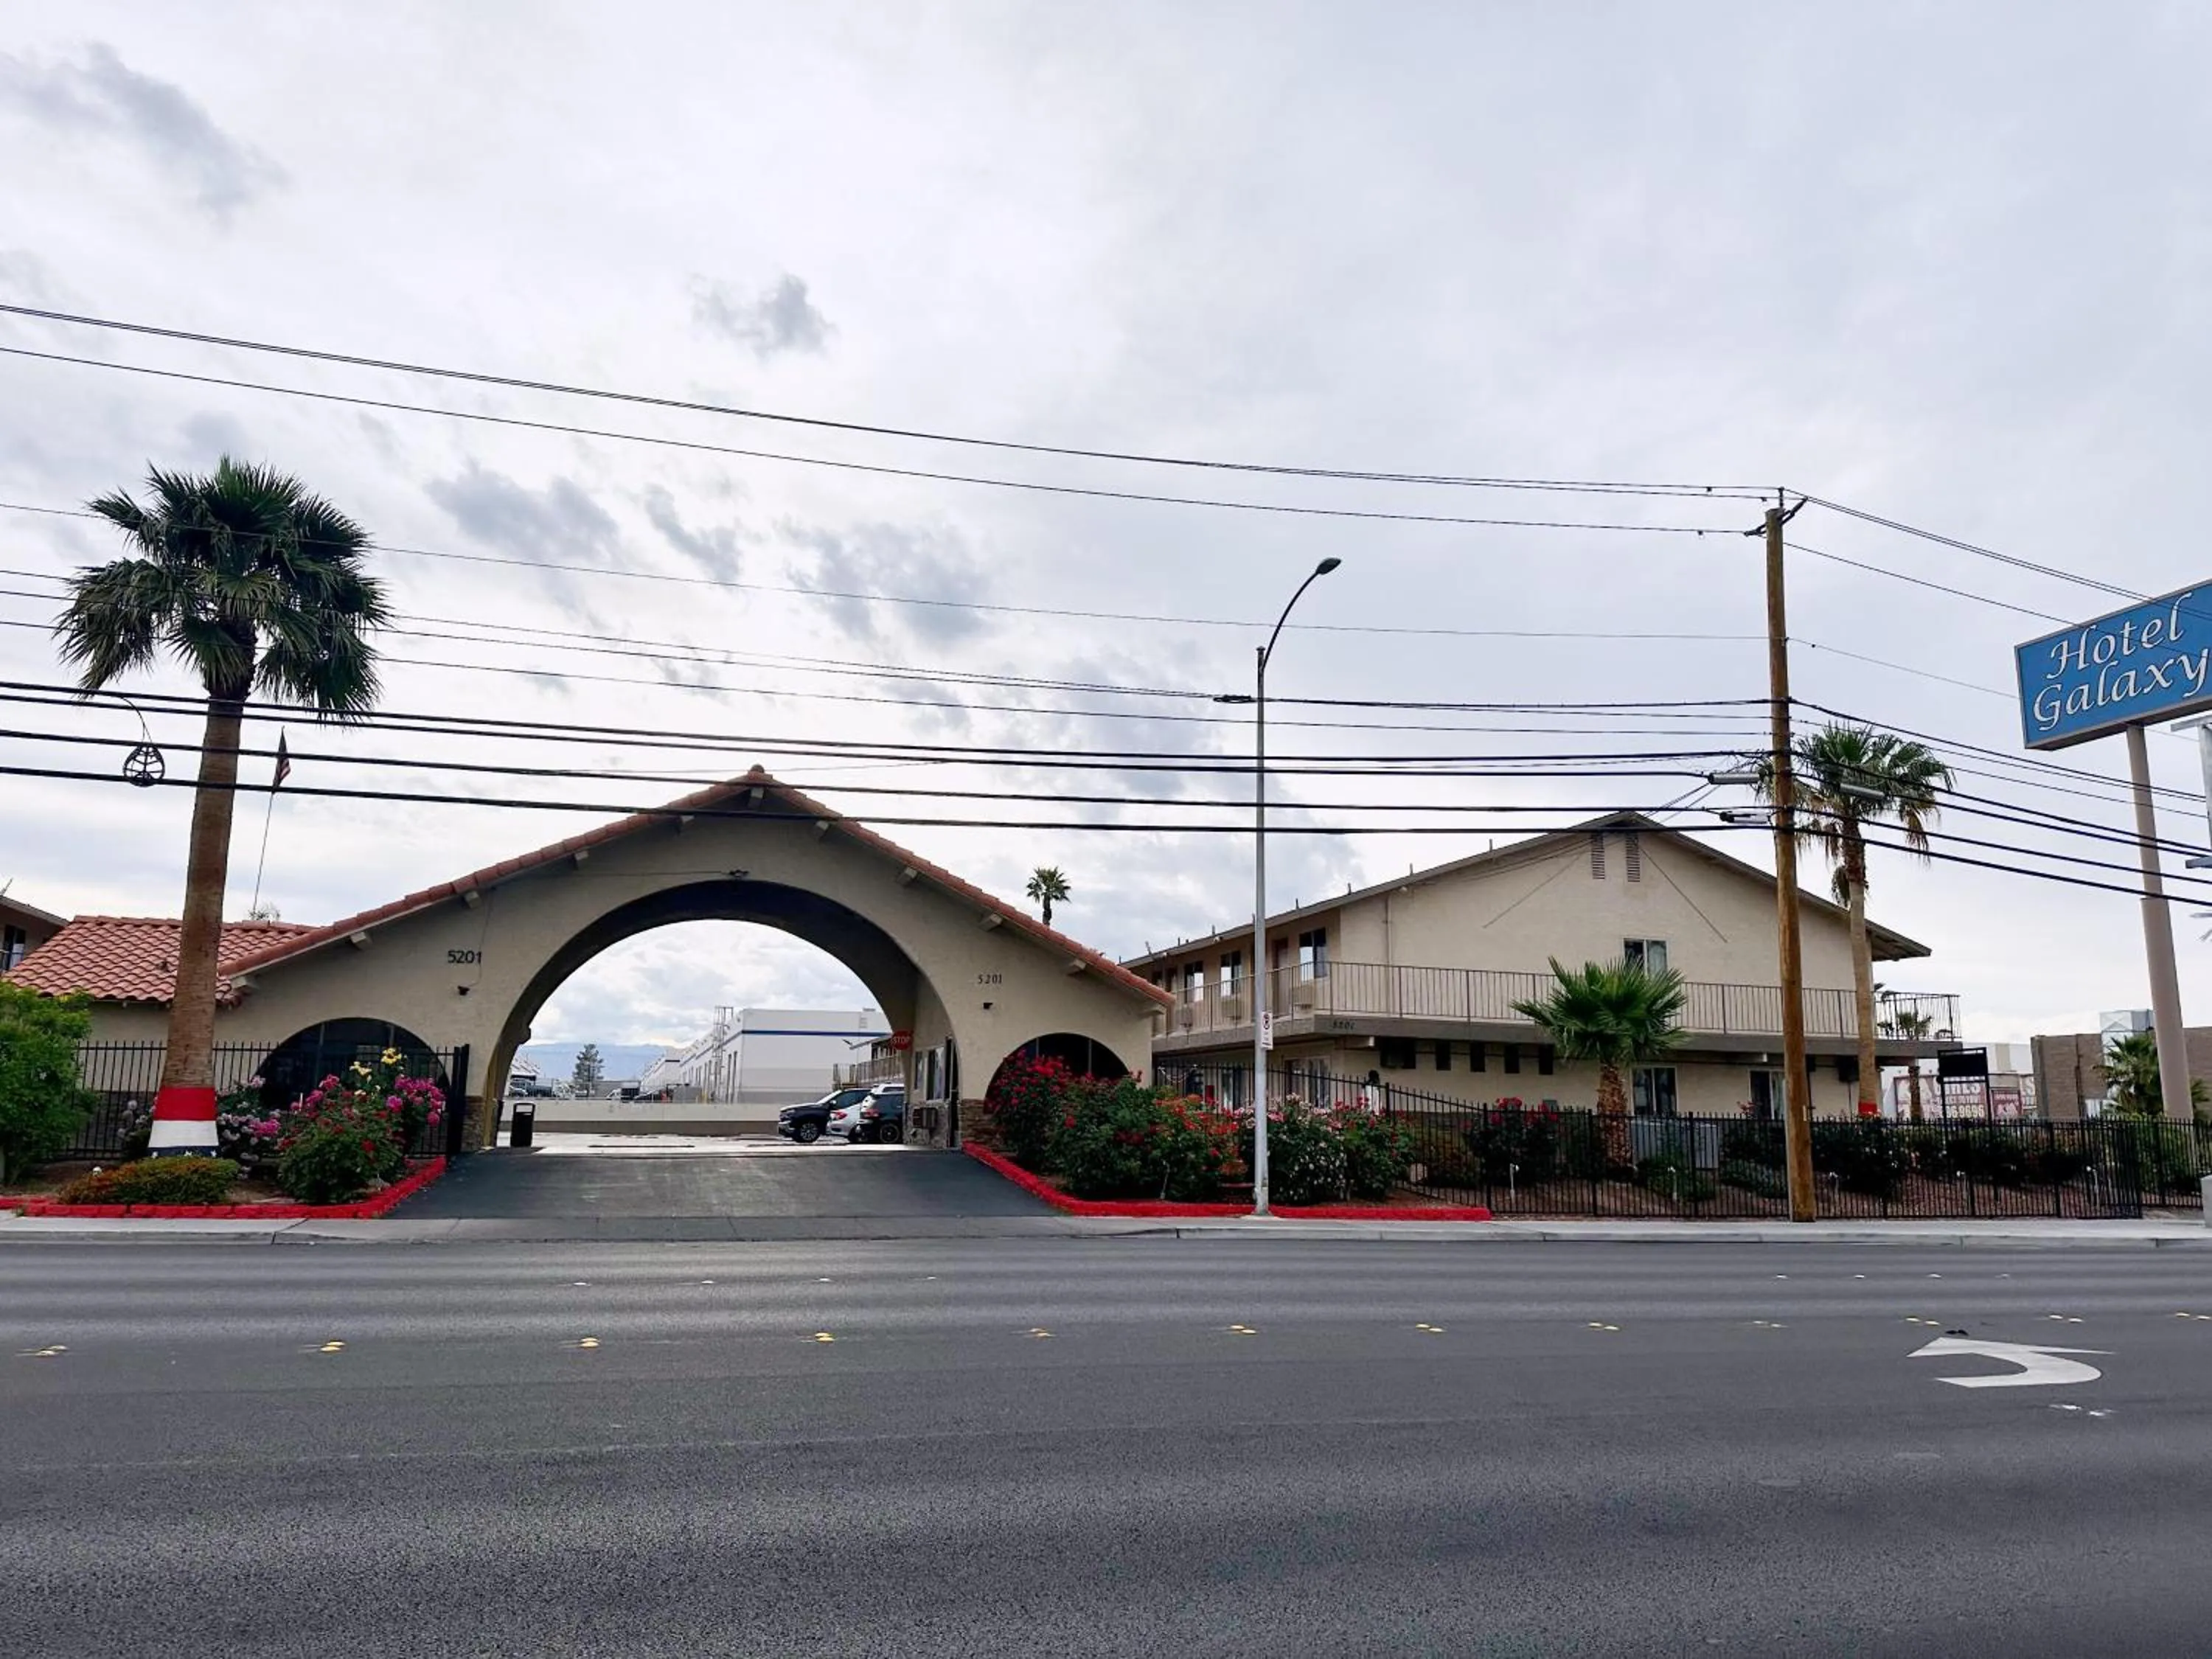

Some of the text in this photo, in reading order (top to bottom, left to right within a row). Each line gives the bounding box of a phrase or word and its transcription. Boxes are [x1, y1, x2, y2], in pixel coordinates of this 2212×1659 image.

[2046, 591, 2192, 679] Hotel
[2033, 647, 2209, 731] Galaxy
[448, 950, 482, 964] 5201
[977, 973, 1002, 984] 5201
